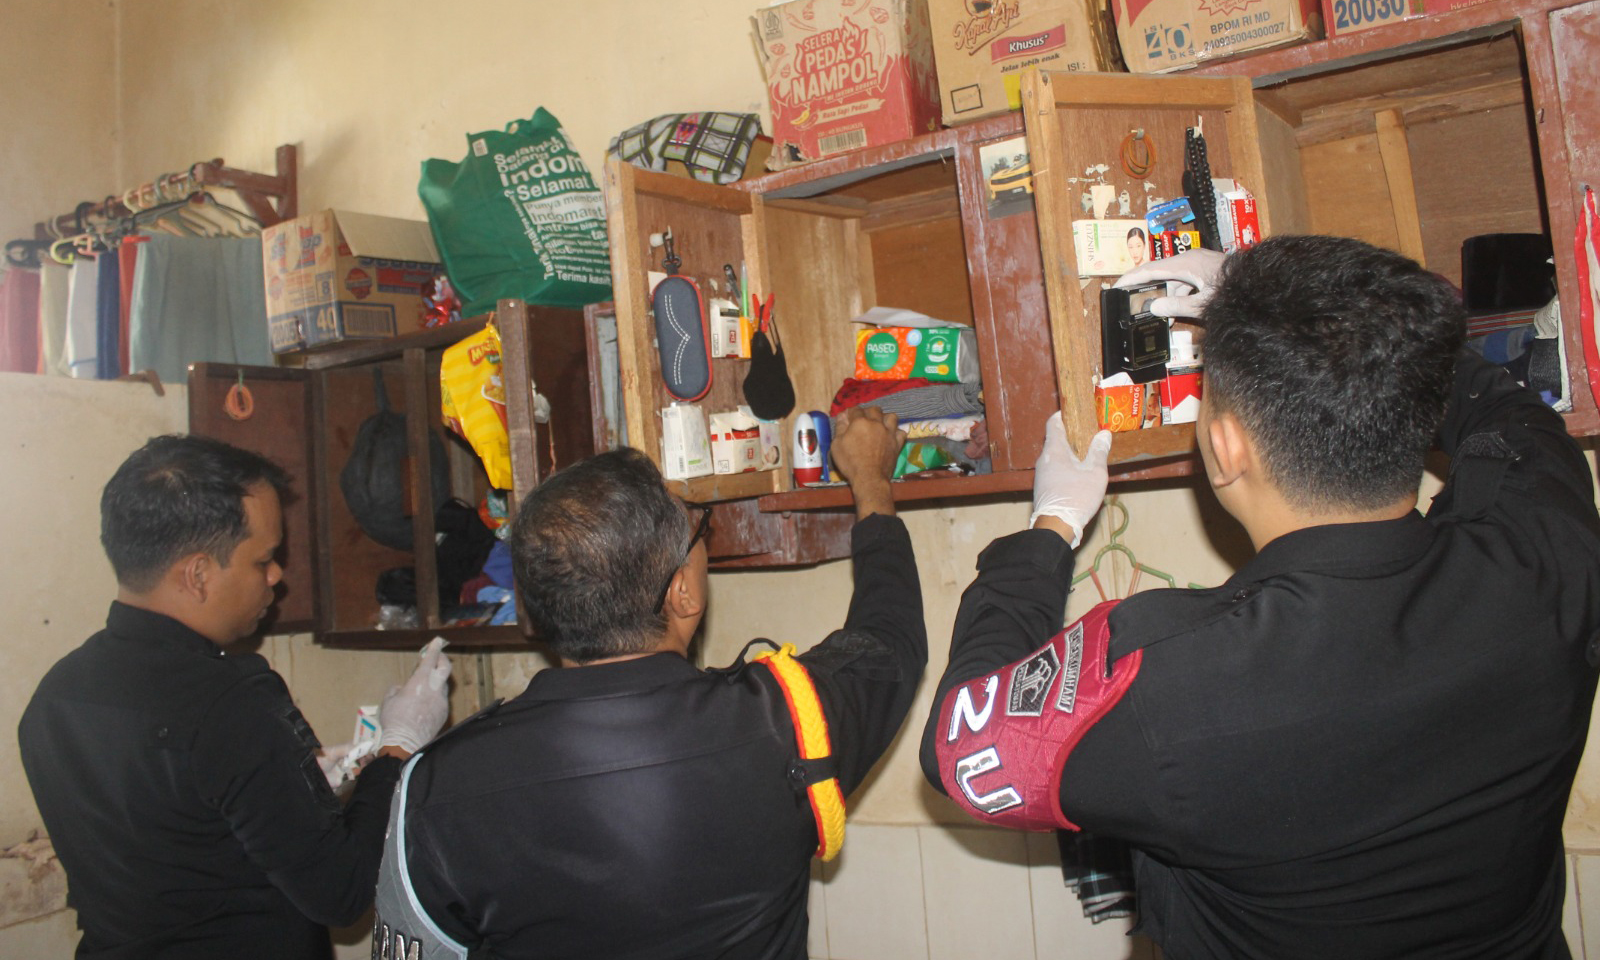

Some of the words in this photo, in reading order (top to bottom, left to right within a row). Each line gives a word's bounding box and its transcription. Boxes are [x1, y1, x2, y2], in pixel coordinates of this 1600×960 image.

[1210, 19, 1240, 35] BPOM
[1243, 15, 1253, 27] RI
[1255, 11, 1271, 23] MD
[804, 30, 840, 52] SELERA
[1009, 36, 1046, 53] Khusus
[1145, 23, 1195, 59] 40
[805, 38, 856, 73] PEDAS
[1000, 63, 1019, 74] Jelas
[1021, 58, 1040, 69] lebih
[1041, 53, 1060, 63] enak
[1170, 49, 1196, 61] BKS
[1067, 61, 1081, 72] ISI
[792, 53, 878, 105] NAMPOL
[556, 270, 587, 283] Terima
[867, 343, 896, 354] PASEO
